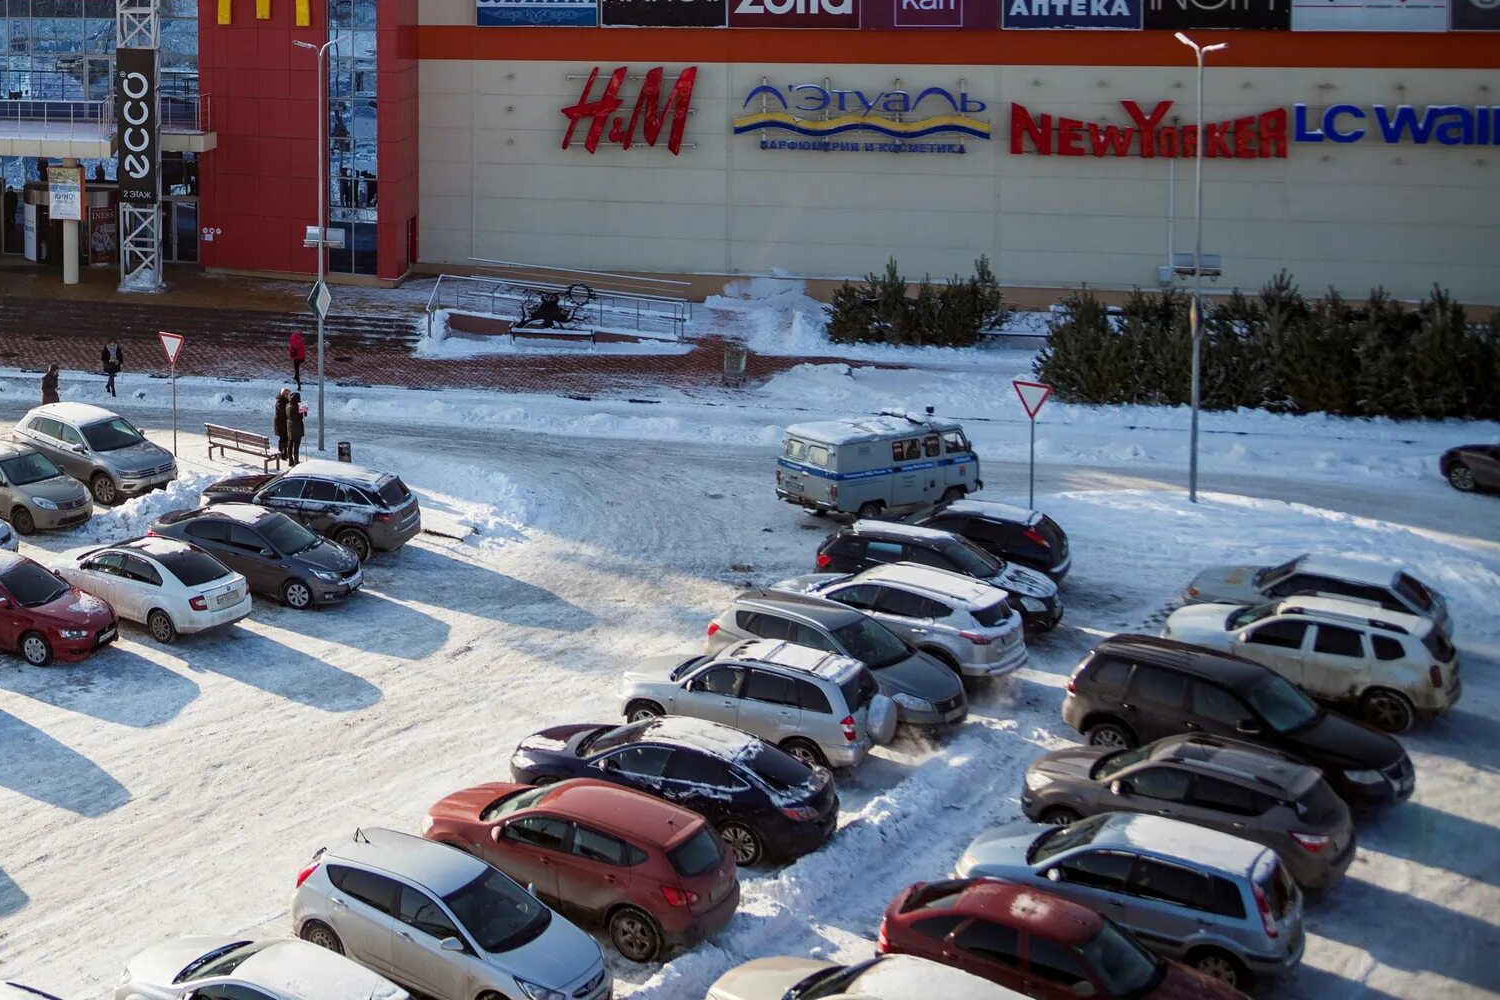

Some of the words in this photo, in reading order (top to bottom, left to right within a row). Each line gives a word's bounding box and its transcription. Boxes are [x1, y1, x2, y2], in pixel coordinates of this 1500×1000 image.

[1009, 0, 1131, 16] АПТЕКА
[122, 72, 150, 179] ecco
[1294, 102, 1367, 143] LC
[760, 140, 860, 152] ПАРФЮМЕРИЯ
[864, 142, 875, 152] И
[877, 142, 967, 154] КОСМЕТИКА
[123, 190, 129, 198] 2
[129, 190, 152, 199] ЭТАЖ
